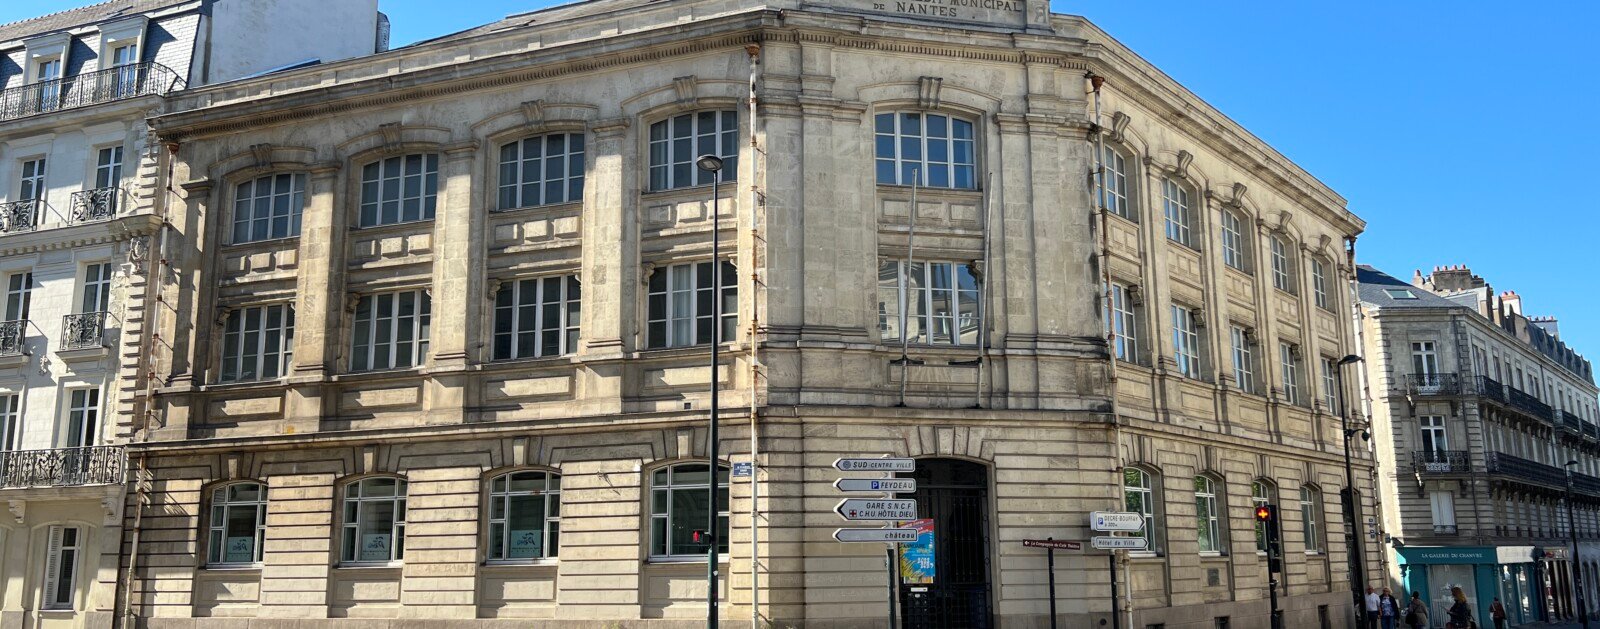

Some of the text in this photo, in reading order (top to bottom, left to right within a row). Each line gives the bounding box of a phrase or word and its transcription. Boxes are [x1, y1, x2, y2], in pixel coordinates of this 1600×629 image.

[896, 1, 957, 17] NANTES
[950, 0, 1022, 12] MUNICIPAL
[880, 481, 913, 489] FEYDEAU
[878, 509, 897, 518] HÔTEL
[898, 510, 914, 518] DIEU
